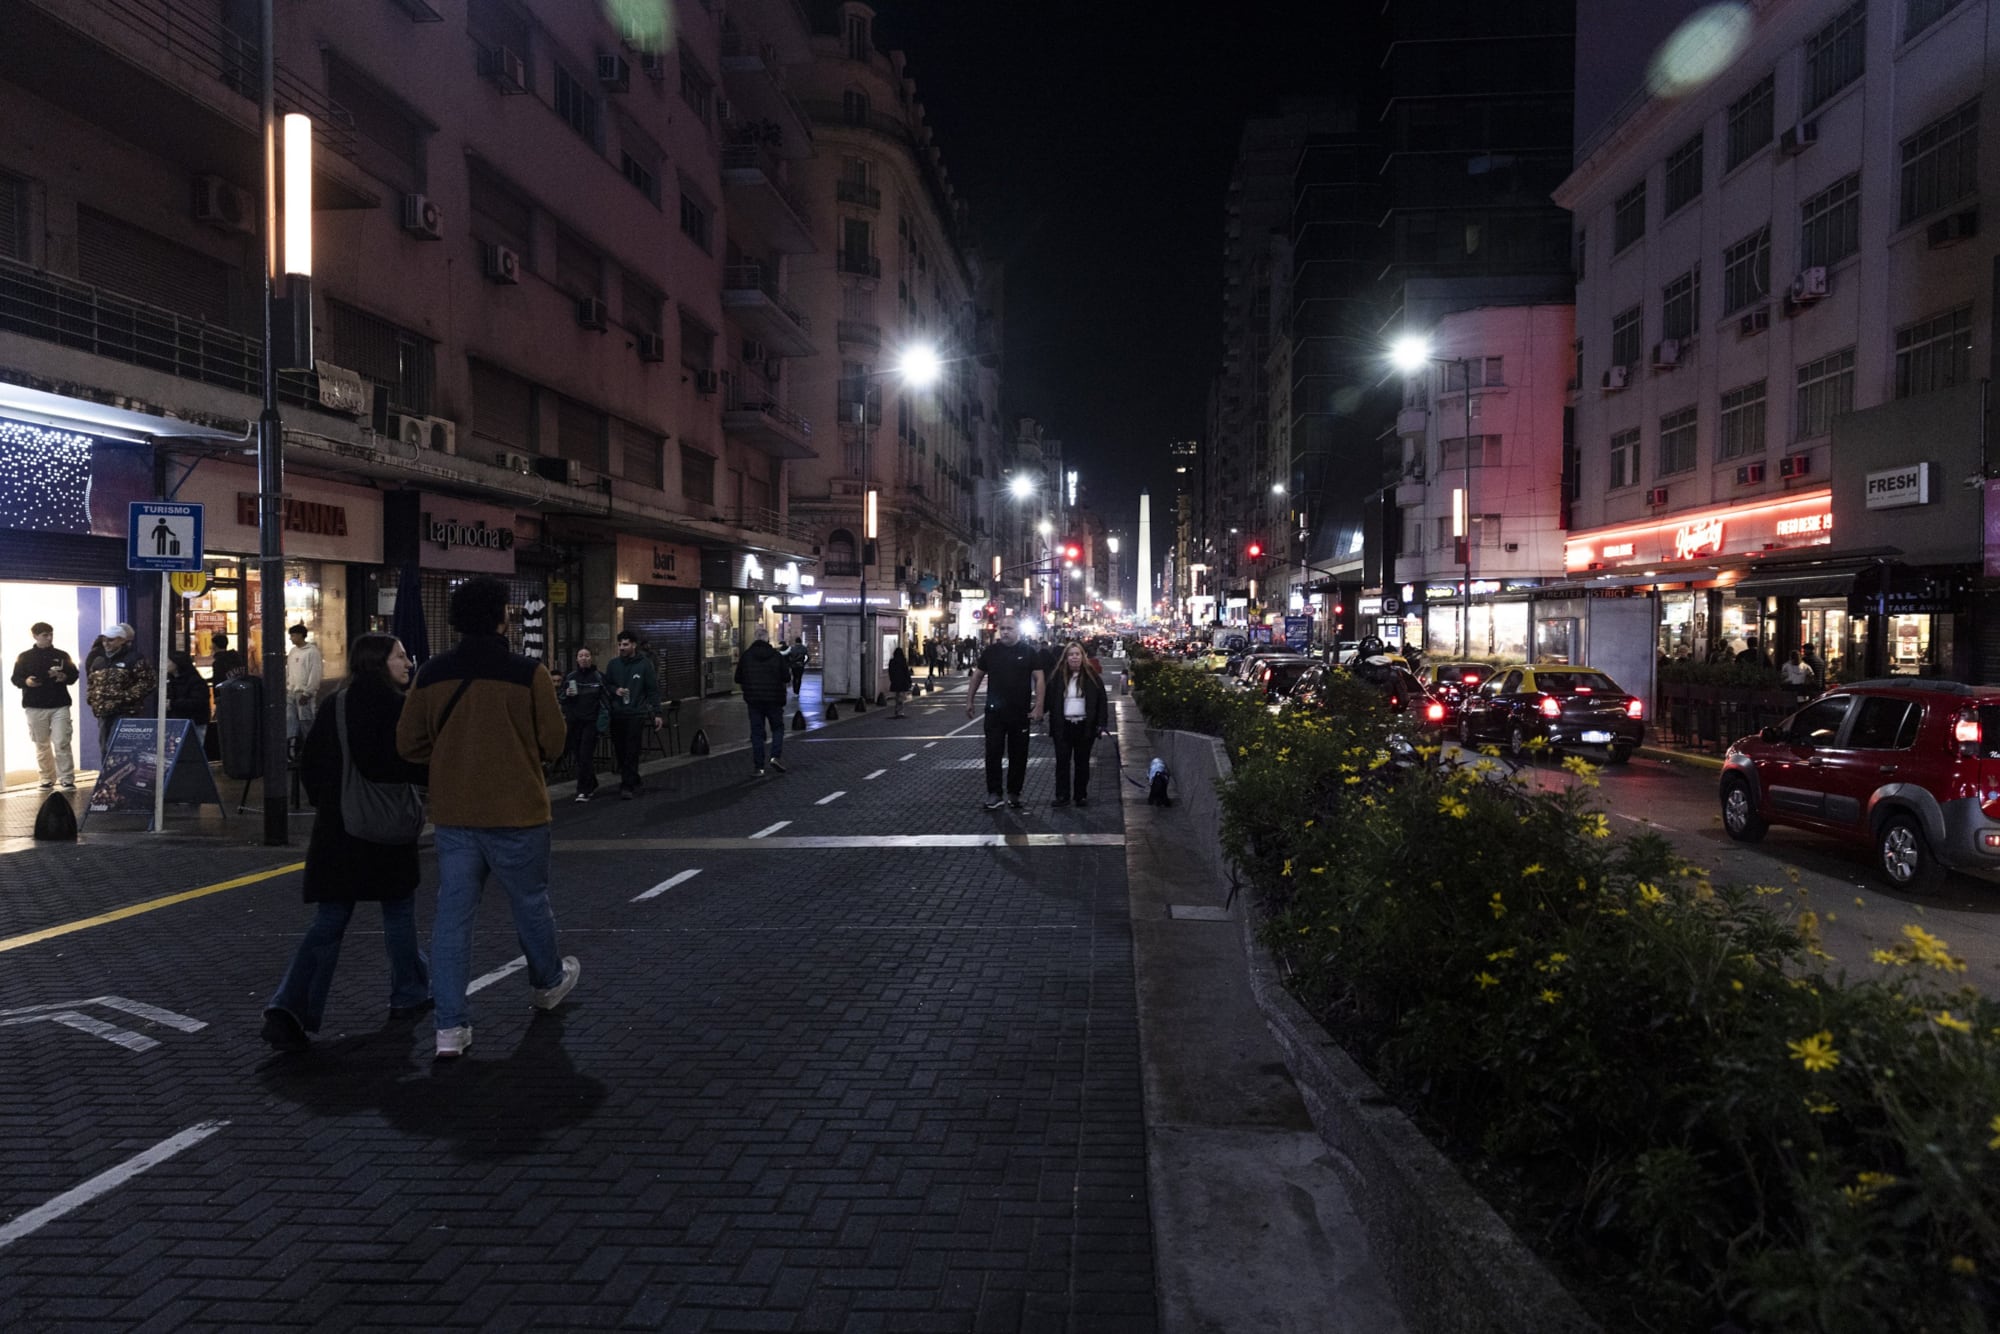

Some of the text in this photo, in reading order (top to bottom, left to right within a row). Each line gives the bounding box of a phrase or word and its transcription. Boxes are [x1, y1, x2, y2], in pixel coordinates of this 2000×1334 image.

[1868, 473, 1917, 494] FRESH
[143, 505, 191, 514] TURISMO
[237, 492, 347, 536] HANNA
[183, 573, 193, 588] H
[1888, 604, 1916, 612] TAKE
[1388, 625, 1397, 635] E
